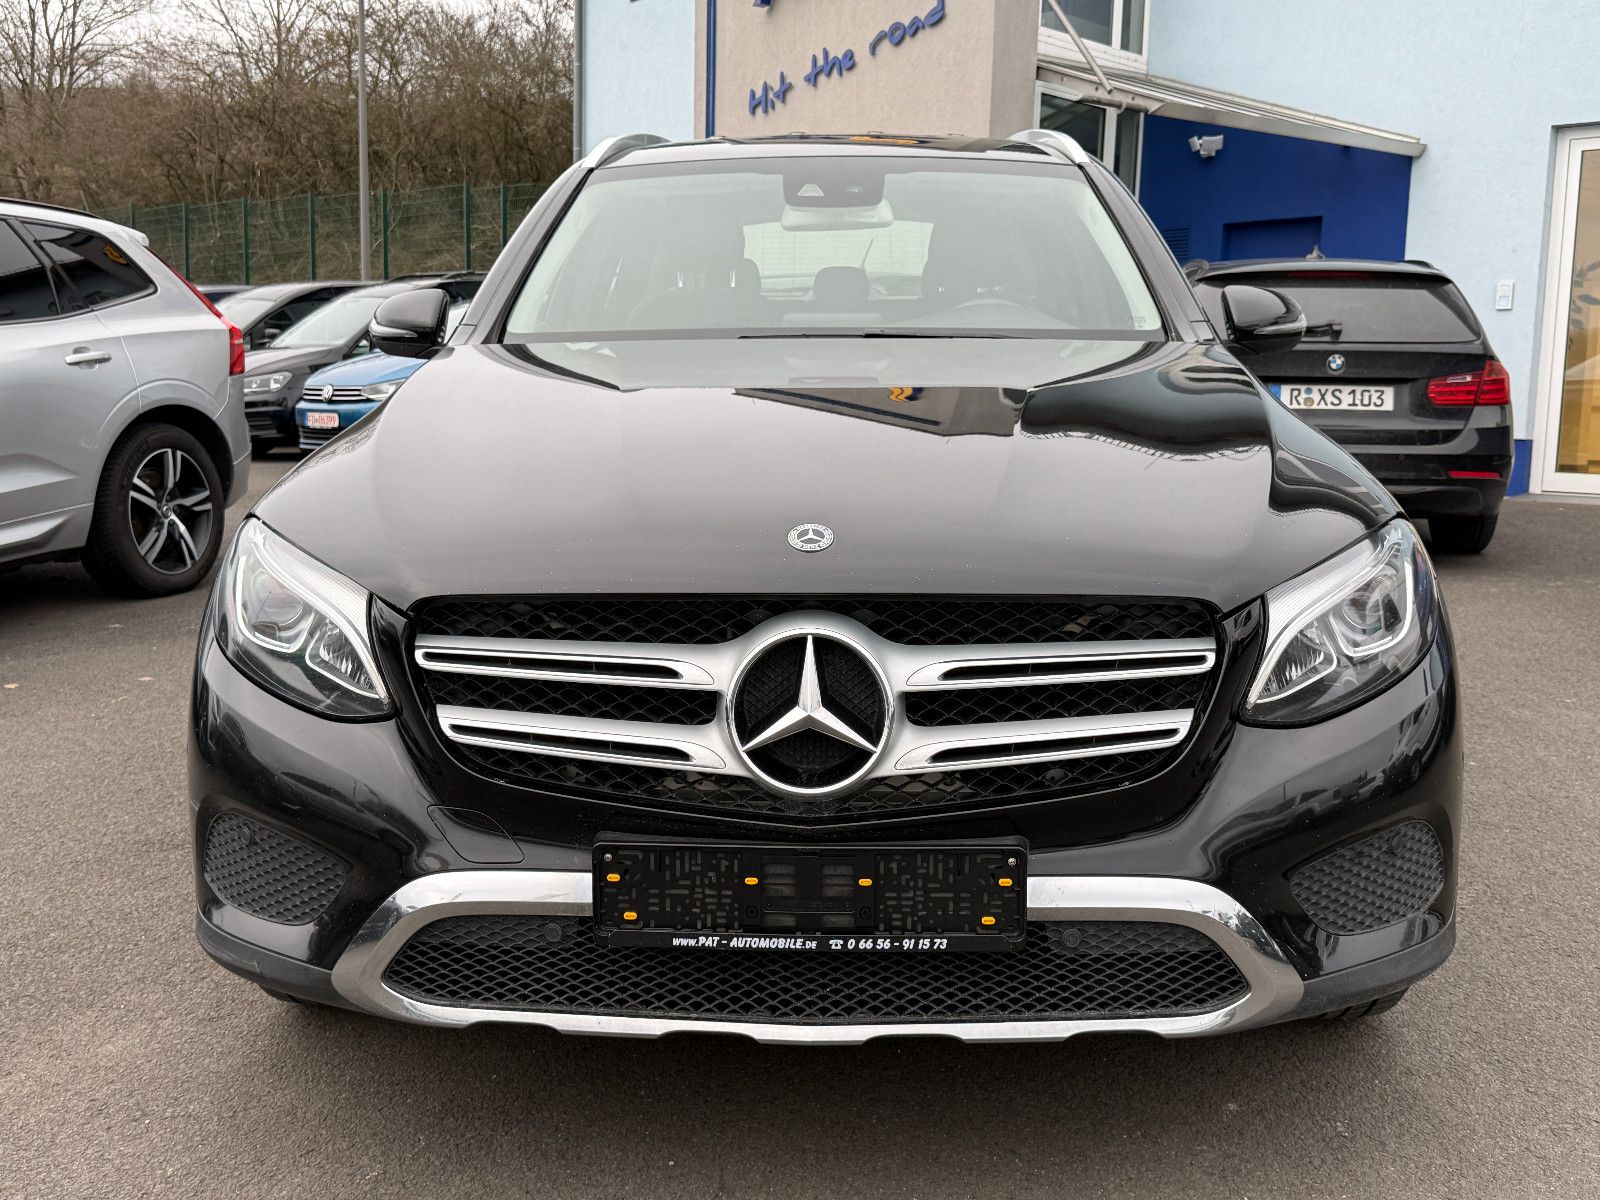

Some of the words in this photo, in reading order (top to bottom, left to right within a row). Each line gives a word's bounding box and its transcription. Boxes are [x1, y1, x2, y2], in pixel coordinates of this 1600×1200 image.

[749, 71, 793, 116] Hit
[804, 47, 856, 88] the
[869, 0, 945, 56] road
[1289, 388, 1301, 406] R
[1316, 388, 1343, 407] XS
[1347, 389, 1385, 408] 103
[672, 936, 720, 947] www.PAT
[729, 936, 818, 949] AUTOMOBILE.DE
[847, 938, 856, 950] 0
[858, 938, 874, 950] 66
[876, 938, 891, 950] 56
[902, 938, 916, 951] 91
[917, 938, 931, 950] 15
[933, 938, 948, 950] 73
